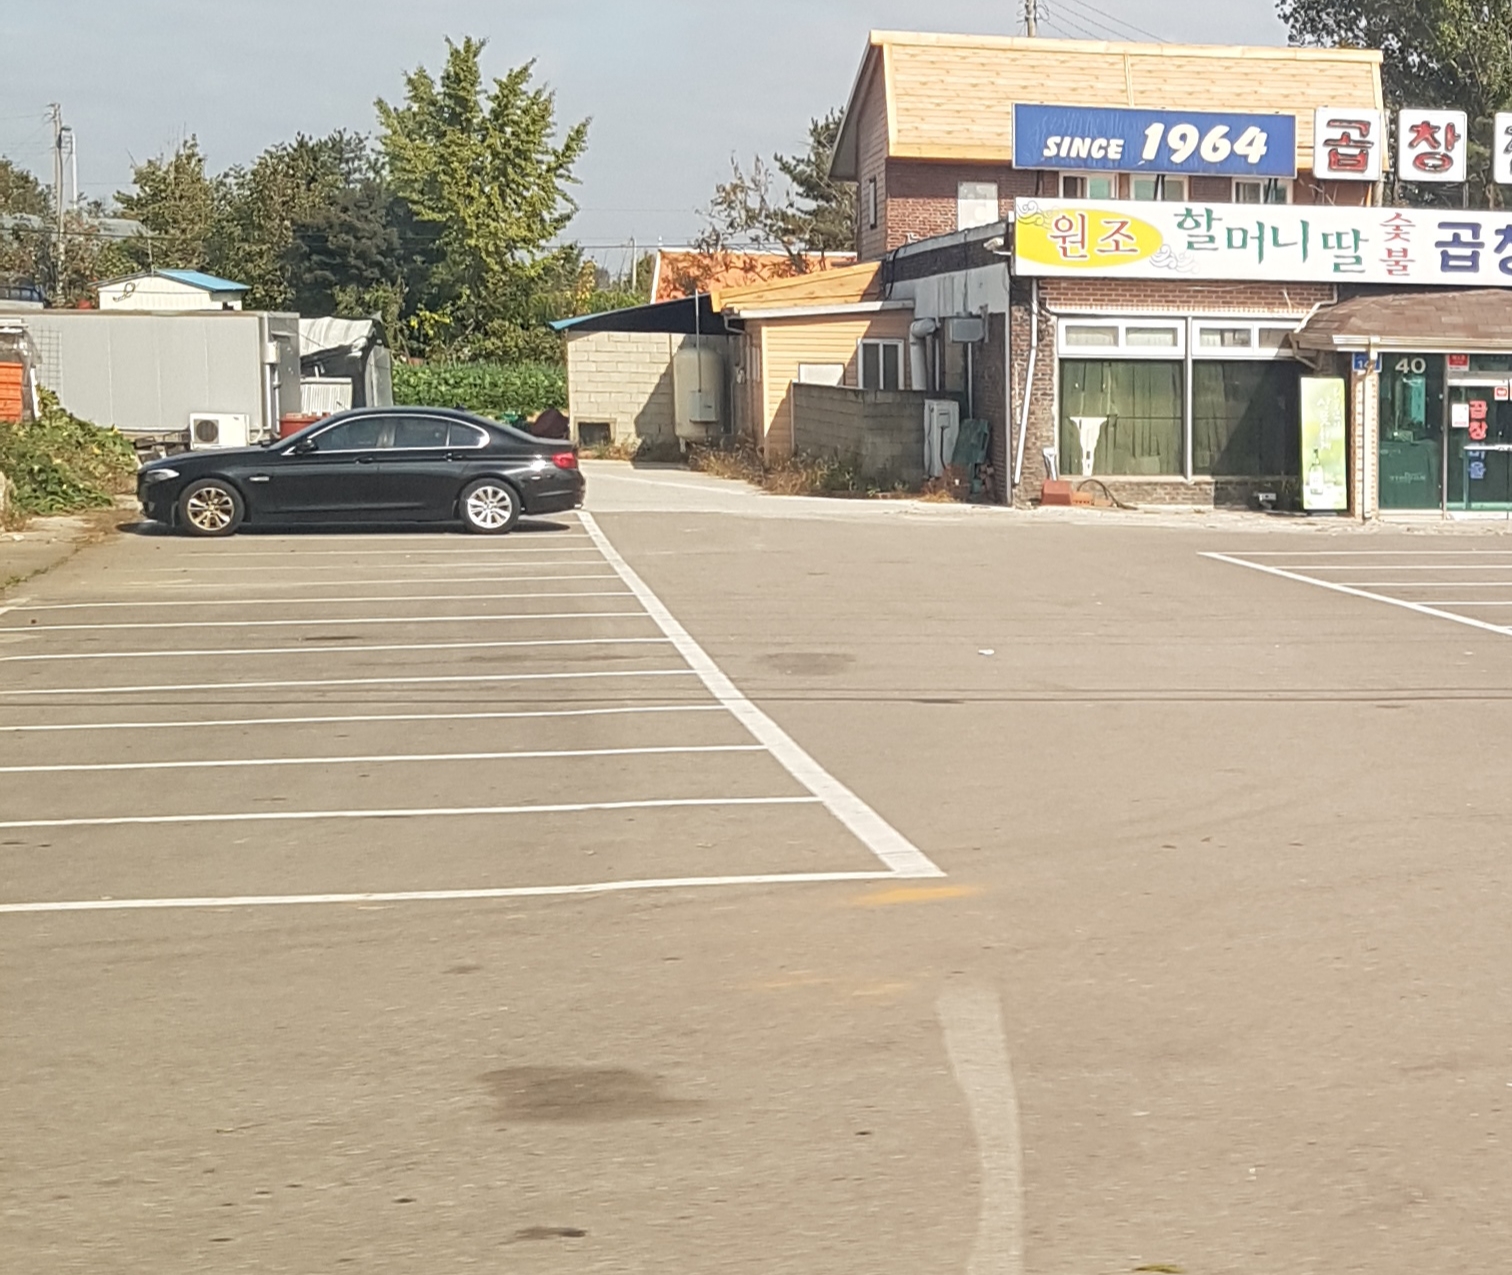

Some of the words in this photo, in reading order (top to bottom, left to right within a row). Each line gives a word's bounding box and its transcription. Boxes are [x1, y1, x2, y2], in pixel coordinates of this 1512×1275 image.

[1043, 136, 1125, 160] SINCE
[1142, 122, 1268, 165] 1964
[1050, 213, 1139, 260] 원조
[1379, 212, 1416, 277] 숯불
[1394, 357, 1427, 374] 40
